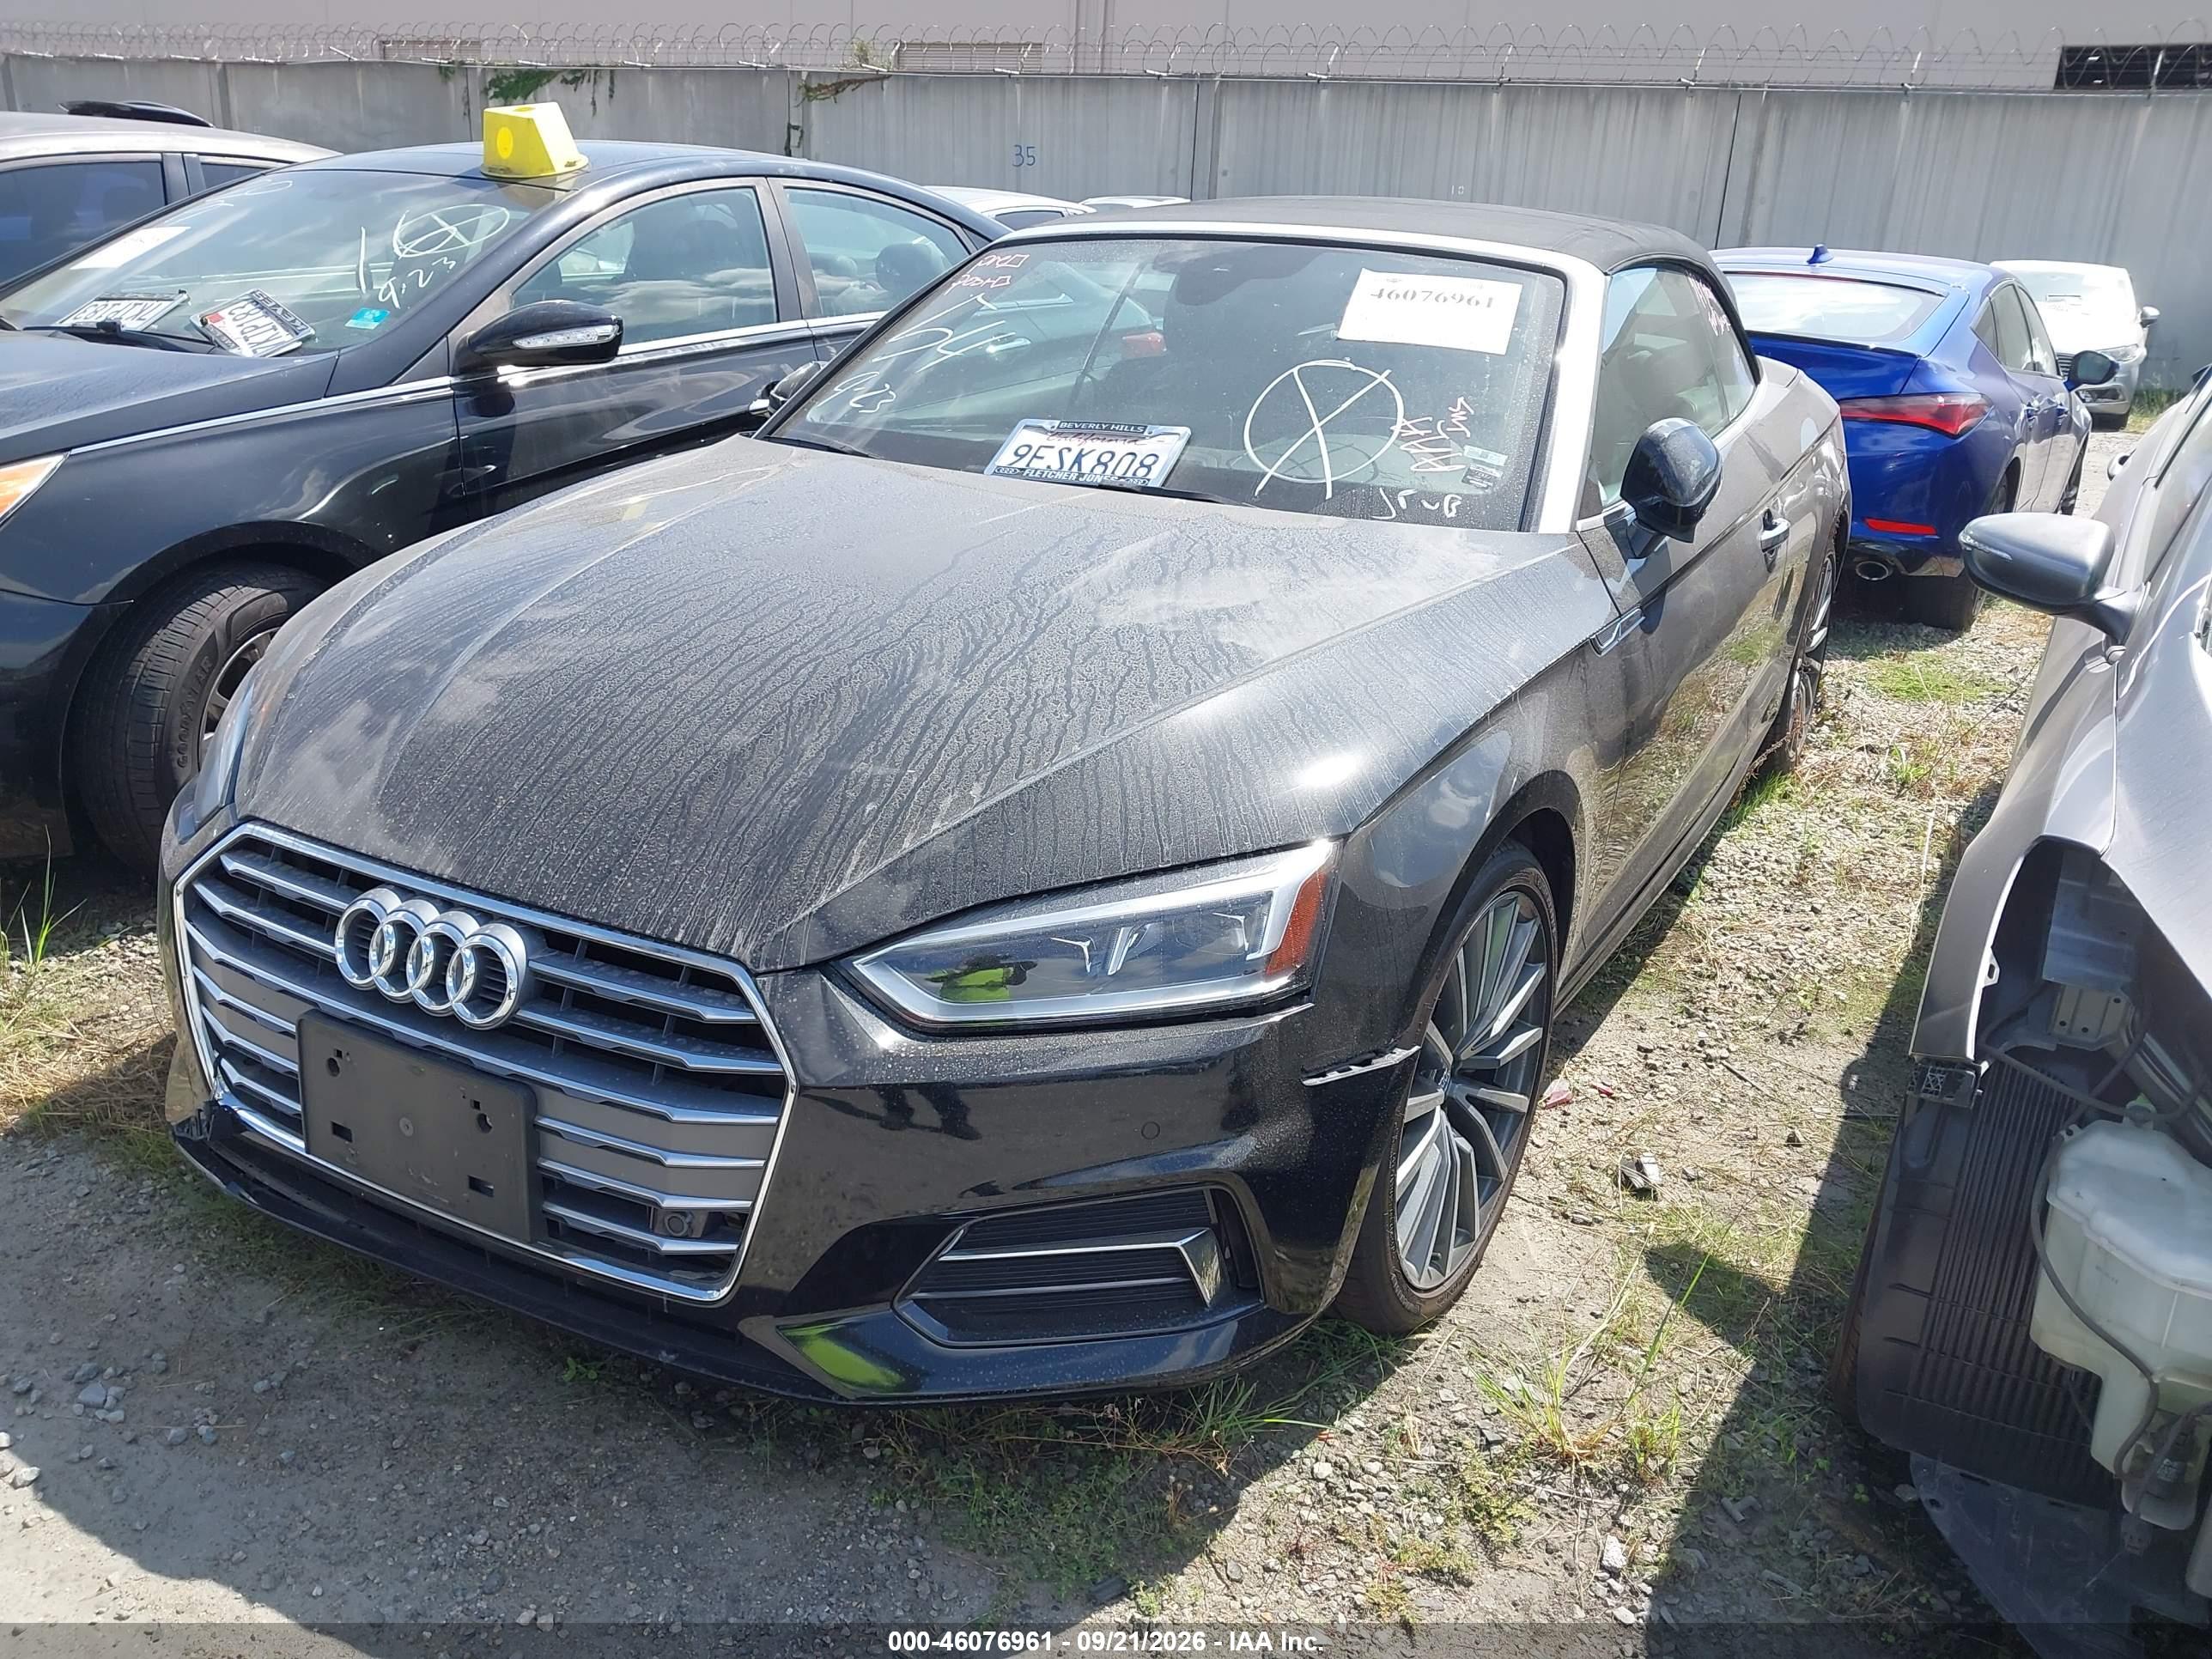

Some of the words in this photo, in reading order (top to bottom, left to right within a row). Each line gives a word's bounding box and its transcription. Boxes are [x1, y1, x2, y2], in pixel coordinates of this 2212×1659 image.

[1012, 144, 1036, 167] 35
[1370, 289, 1493, 308] 46076961
[254, 291, 307, 331] KEYES
[1059, 422, 1109, 431] BEVERLY
[1110, 423, 1146, 433] HILLS
[1023, 469, 1079, 482] FLETCHER
